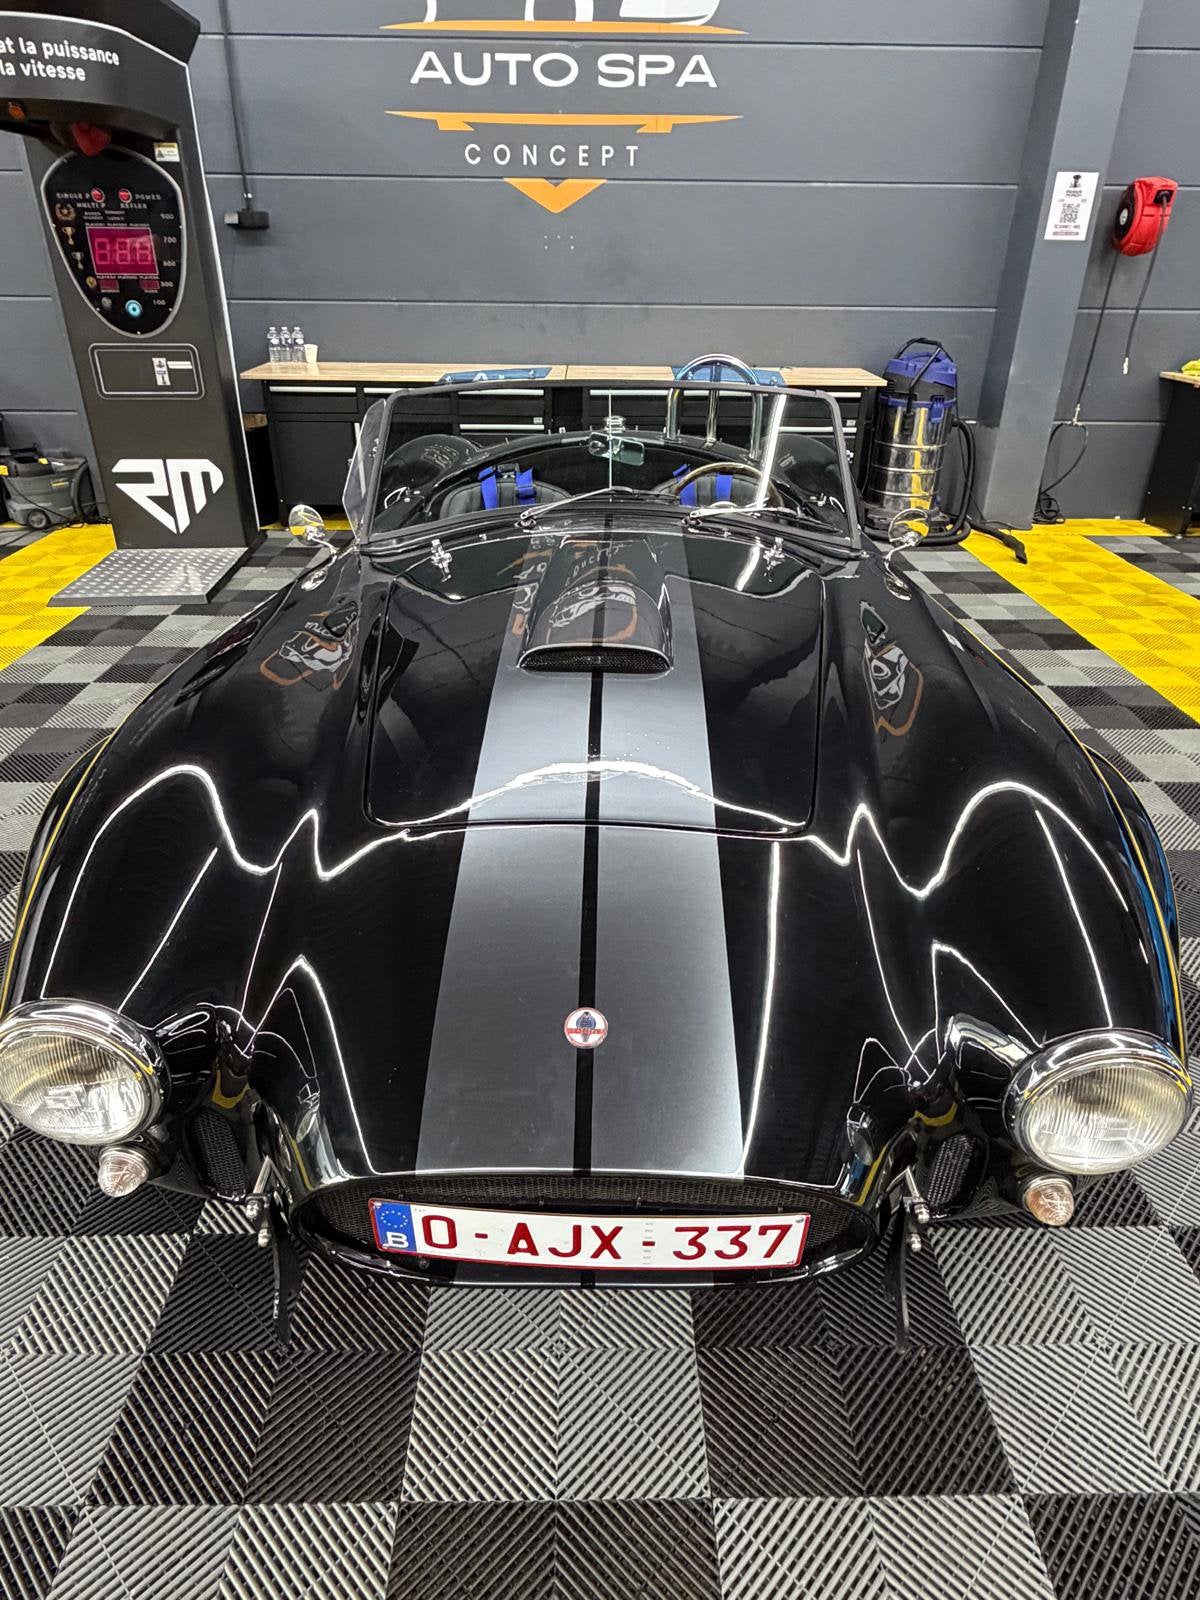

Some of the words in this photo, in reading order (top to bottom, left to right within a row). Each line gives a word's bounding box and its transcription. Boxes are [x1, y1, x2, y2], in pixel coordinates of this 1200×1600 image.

[18, 36, 37, 54] la
[42, 40, 120, 65] puissance
[0, 59, 16, 76] la
[20, 59, 86, 81] vitesse
[410, 51, 578, 87] AUTO
[598, 53, 717, 88] SPA
[464, 144, 638, 166] CONCEPT
[386, 1231, 409, 1249] B
